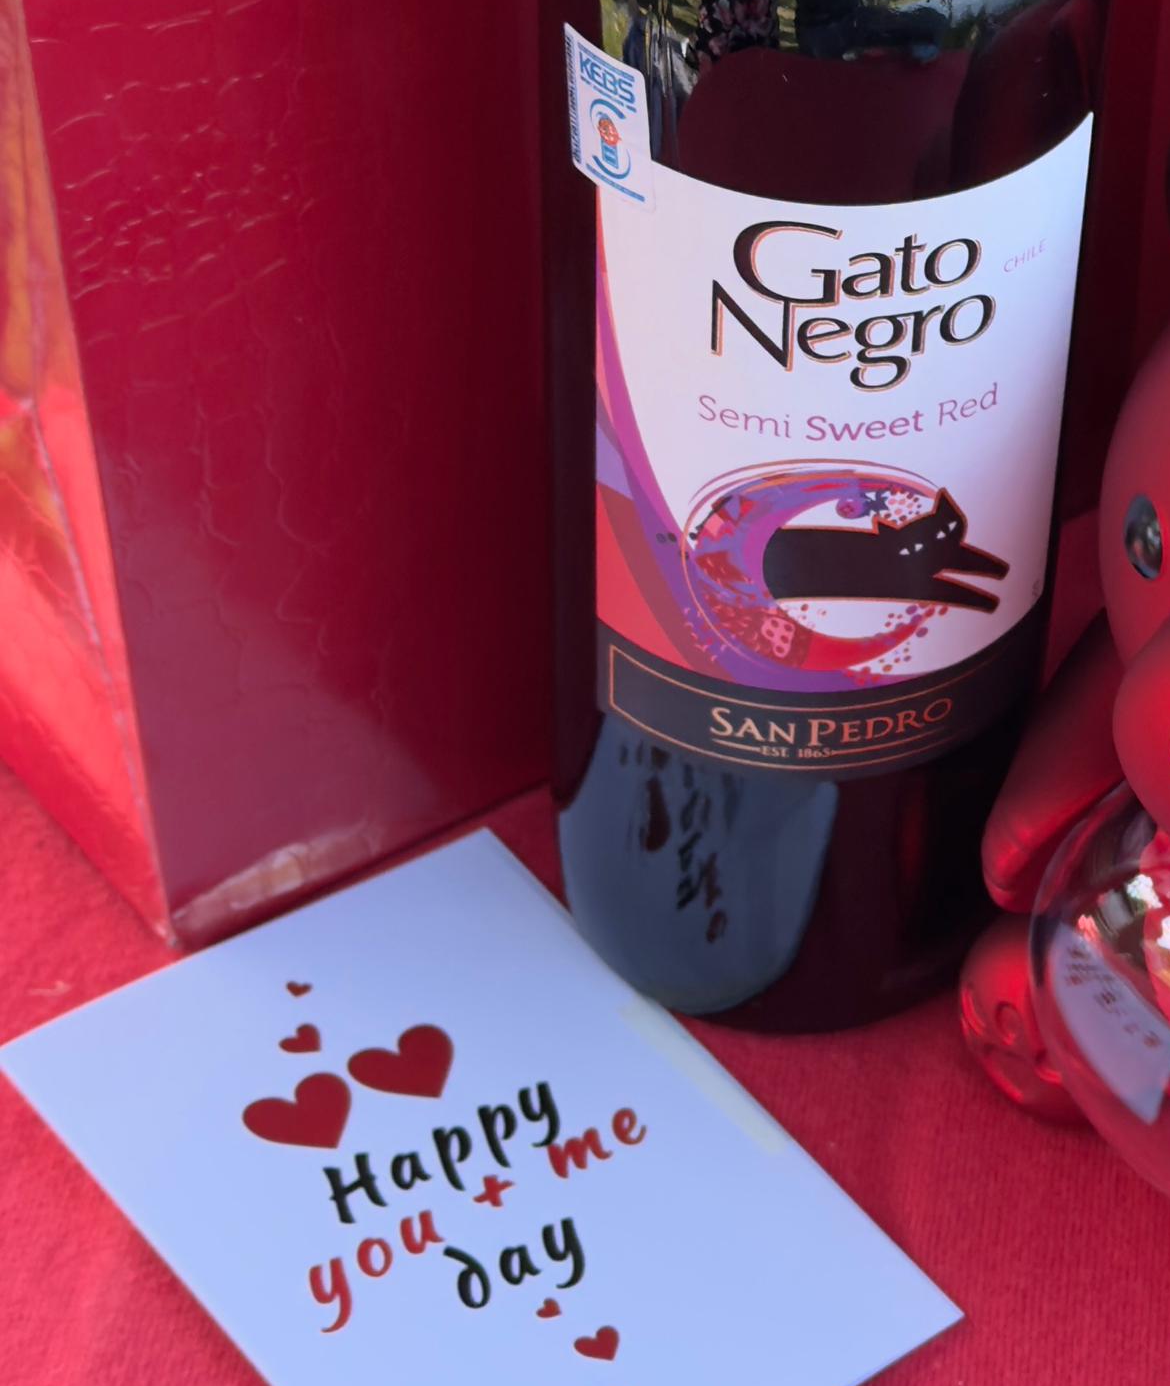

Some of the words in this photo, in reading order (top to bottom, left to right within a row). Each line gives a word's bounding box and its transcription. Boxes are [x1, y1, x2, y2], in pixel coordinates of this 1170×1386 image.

[578, 51, 636, 105] KEBS
[733, 220, 982, 307] Gato
[1003, 238, 1048, 273] CHILE
[711, 279, 996, 392] Negro
[698, 395, 792, 439] Semi
[805, 410, 924, 442] Sweet
[937, 382, 999, 427] Red
[709, 706, 796, 745] SAN
[807, 697, 953, 747] PEDRO
[797, 747, 832, 759] 1865
[322, 1081, 561, 1225] Happy
[308, 1209, 444, 1334] you
[547, 1107, 647, 1179] me
[442, 1216, 586, 1310] day
